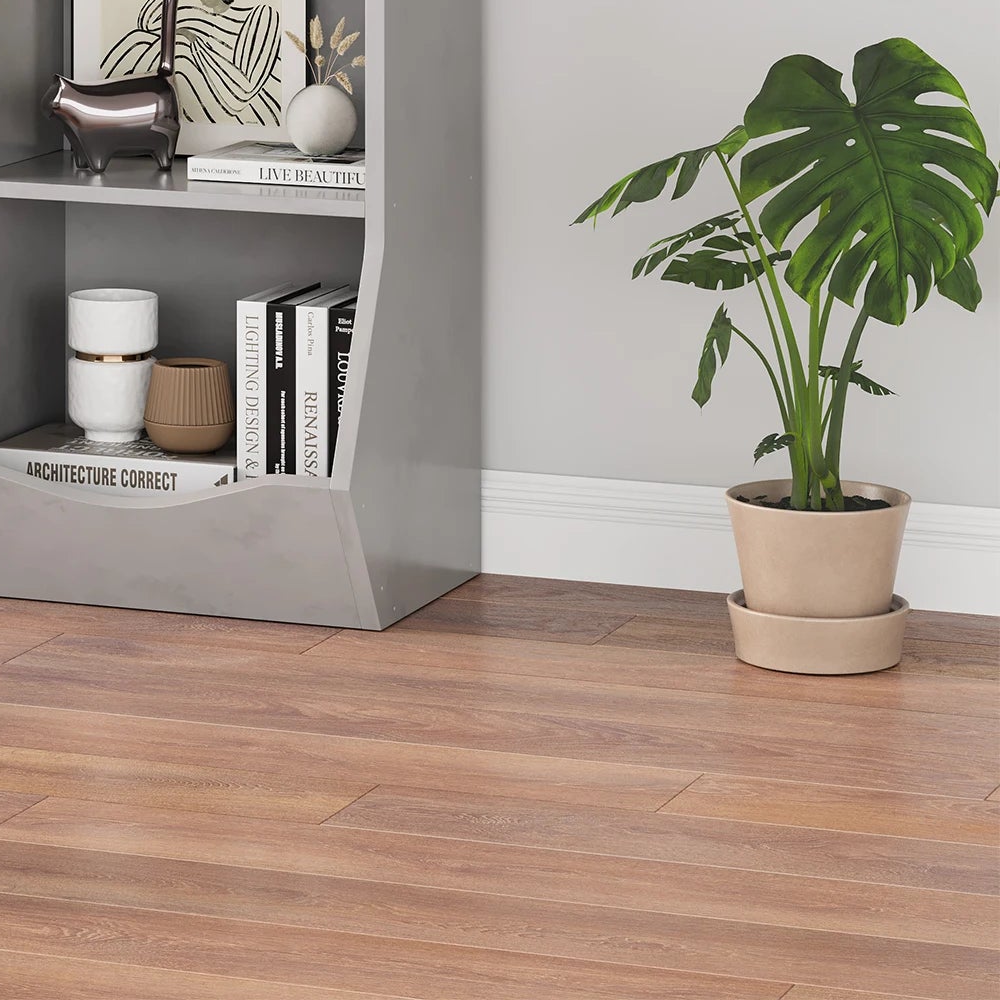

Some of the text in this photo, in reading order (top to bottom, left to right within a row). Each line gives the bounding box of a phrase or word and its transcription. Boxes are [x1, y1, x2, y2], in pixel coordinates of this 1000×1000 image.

[259, 167, 292, 181] LIVE
[245, 316, 259, 470] LIGHTING DESIGN &
[26, 462, 177, 491] ARCHITECTURE CORRECT
